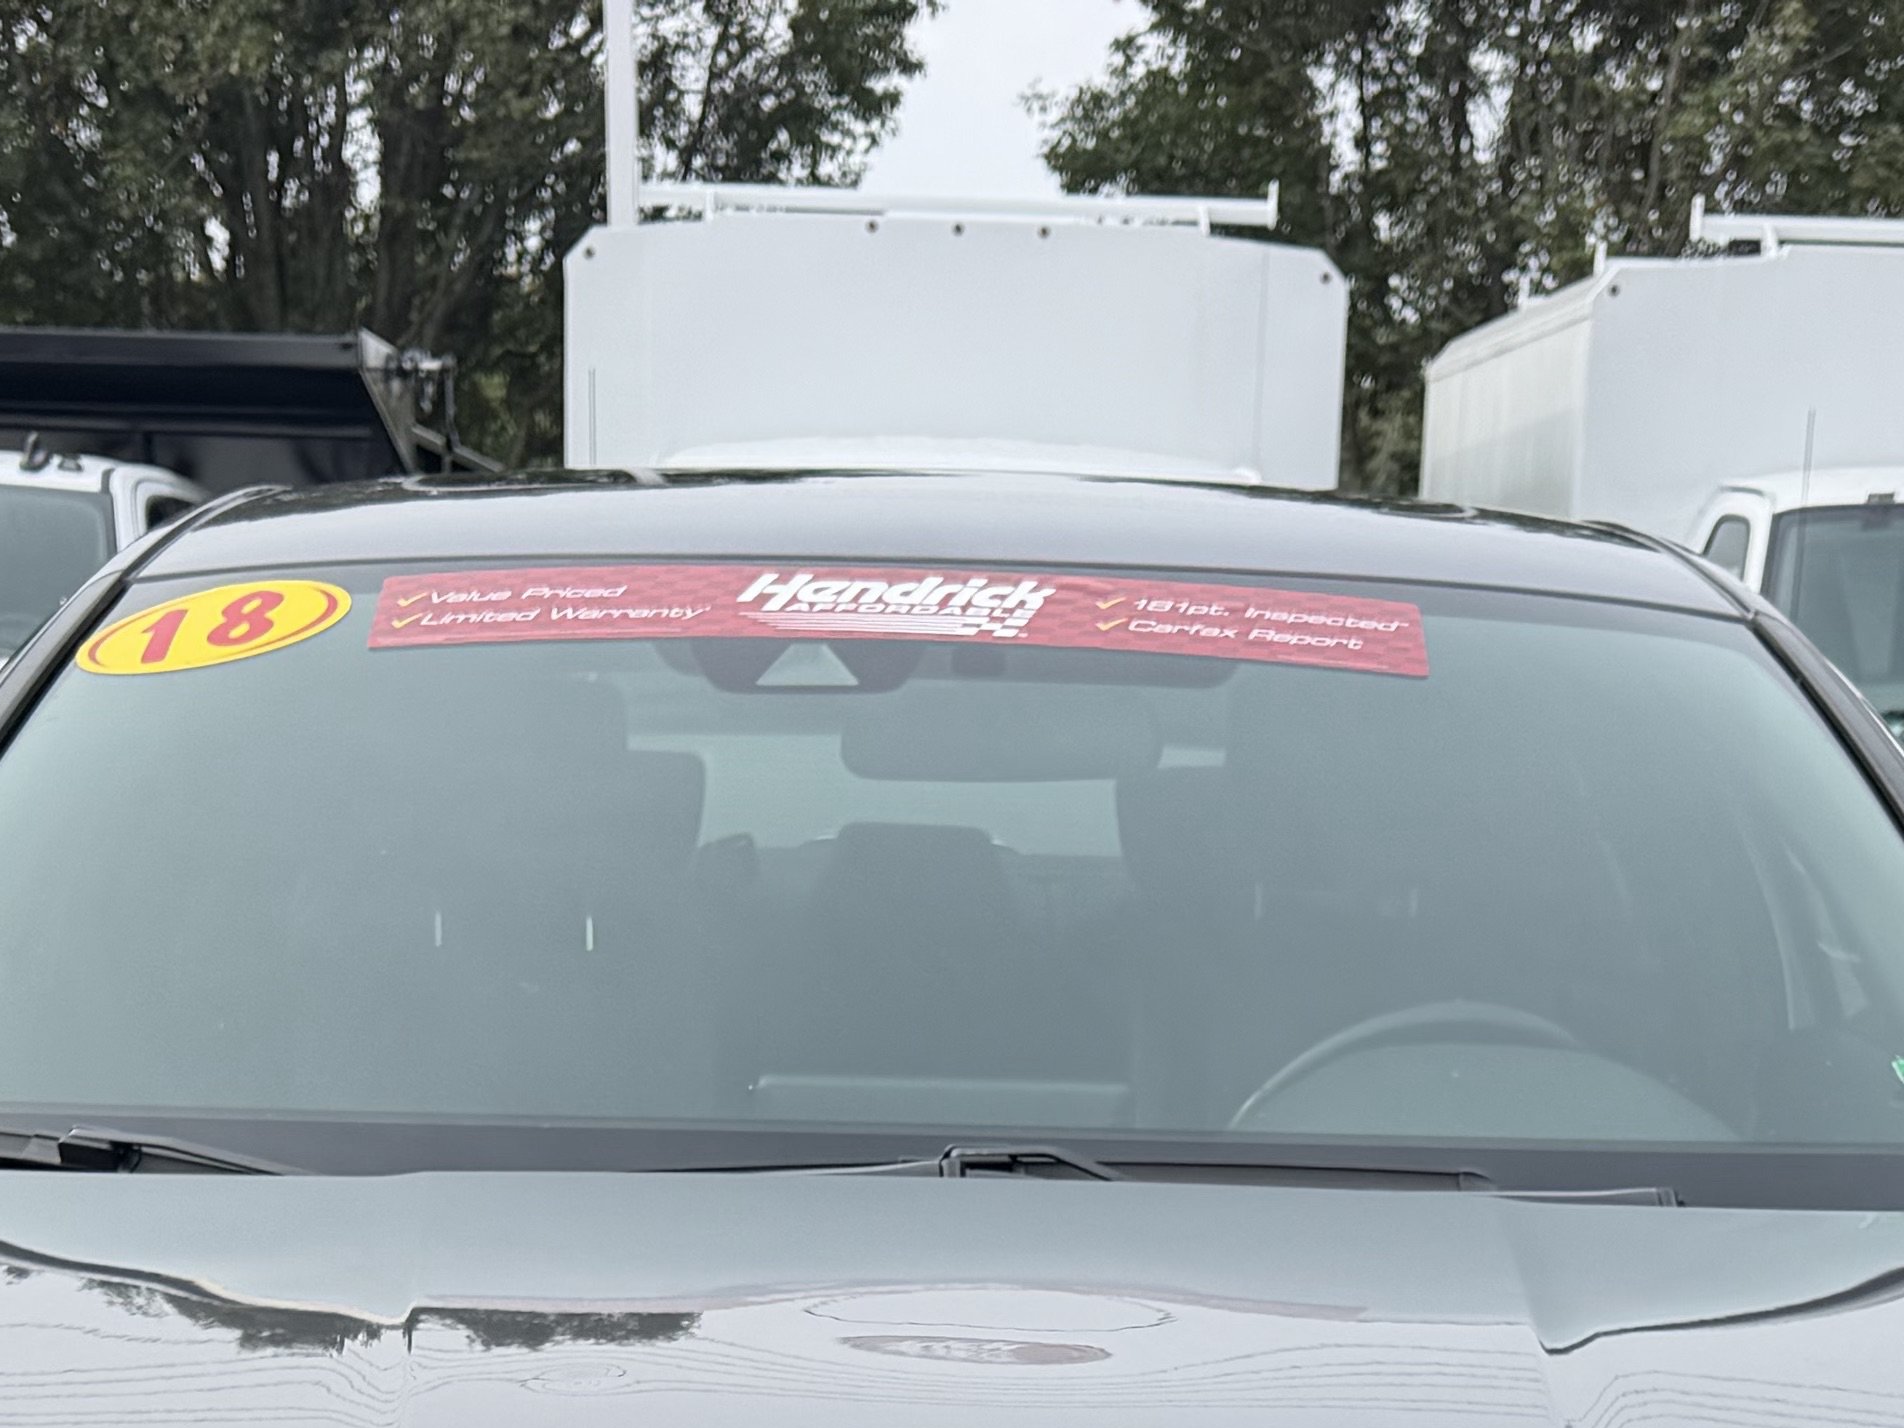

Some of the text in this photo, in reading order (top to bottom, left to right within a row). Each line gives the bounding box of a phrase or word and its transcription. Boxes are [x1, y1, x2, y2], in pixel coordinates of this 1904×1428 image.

[430, 585, 629, 604] Value Priced
[735, 572, 1057, 613] Hendrick
[419, 608, 542, 627] Limited
[784, 602, 1038, 619] AFFORDABLE
[140, 590, 285, 664] 18
[1128, 619, 1365, 651] Carfax Report
